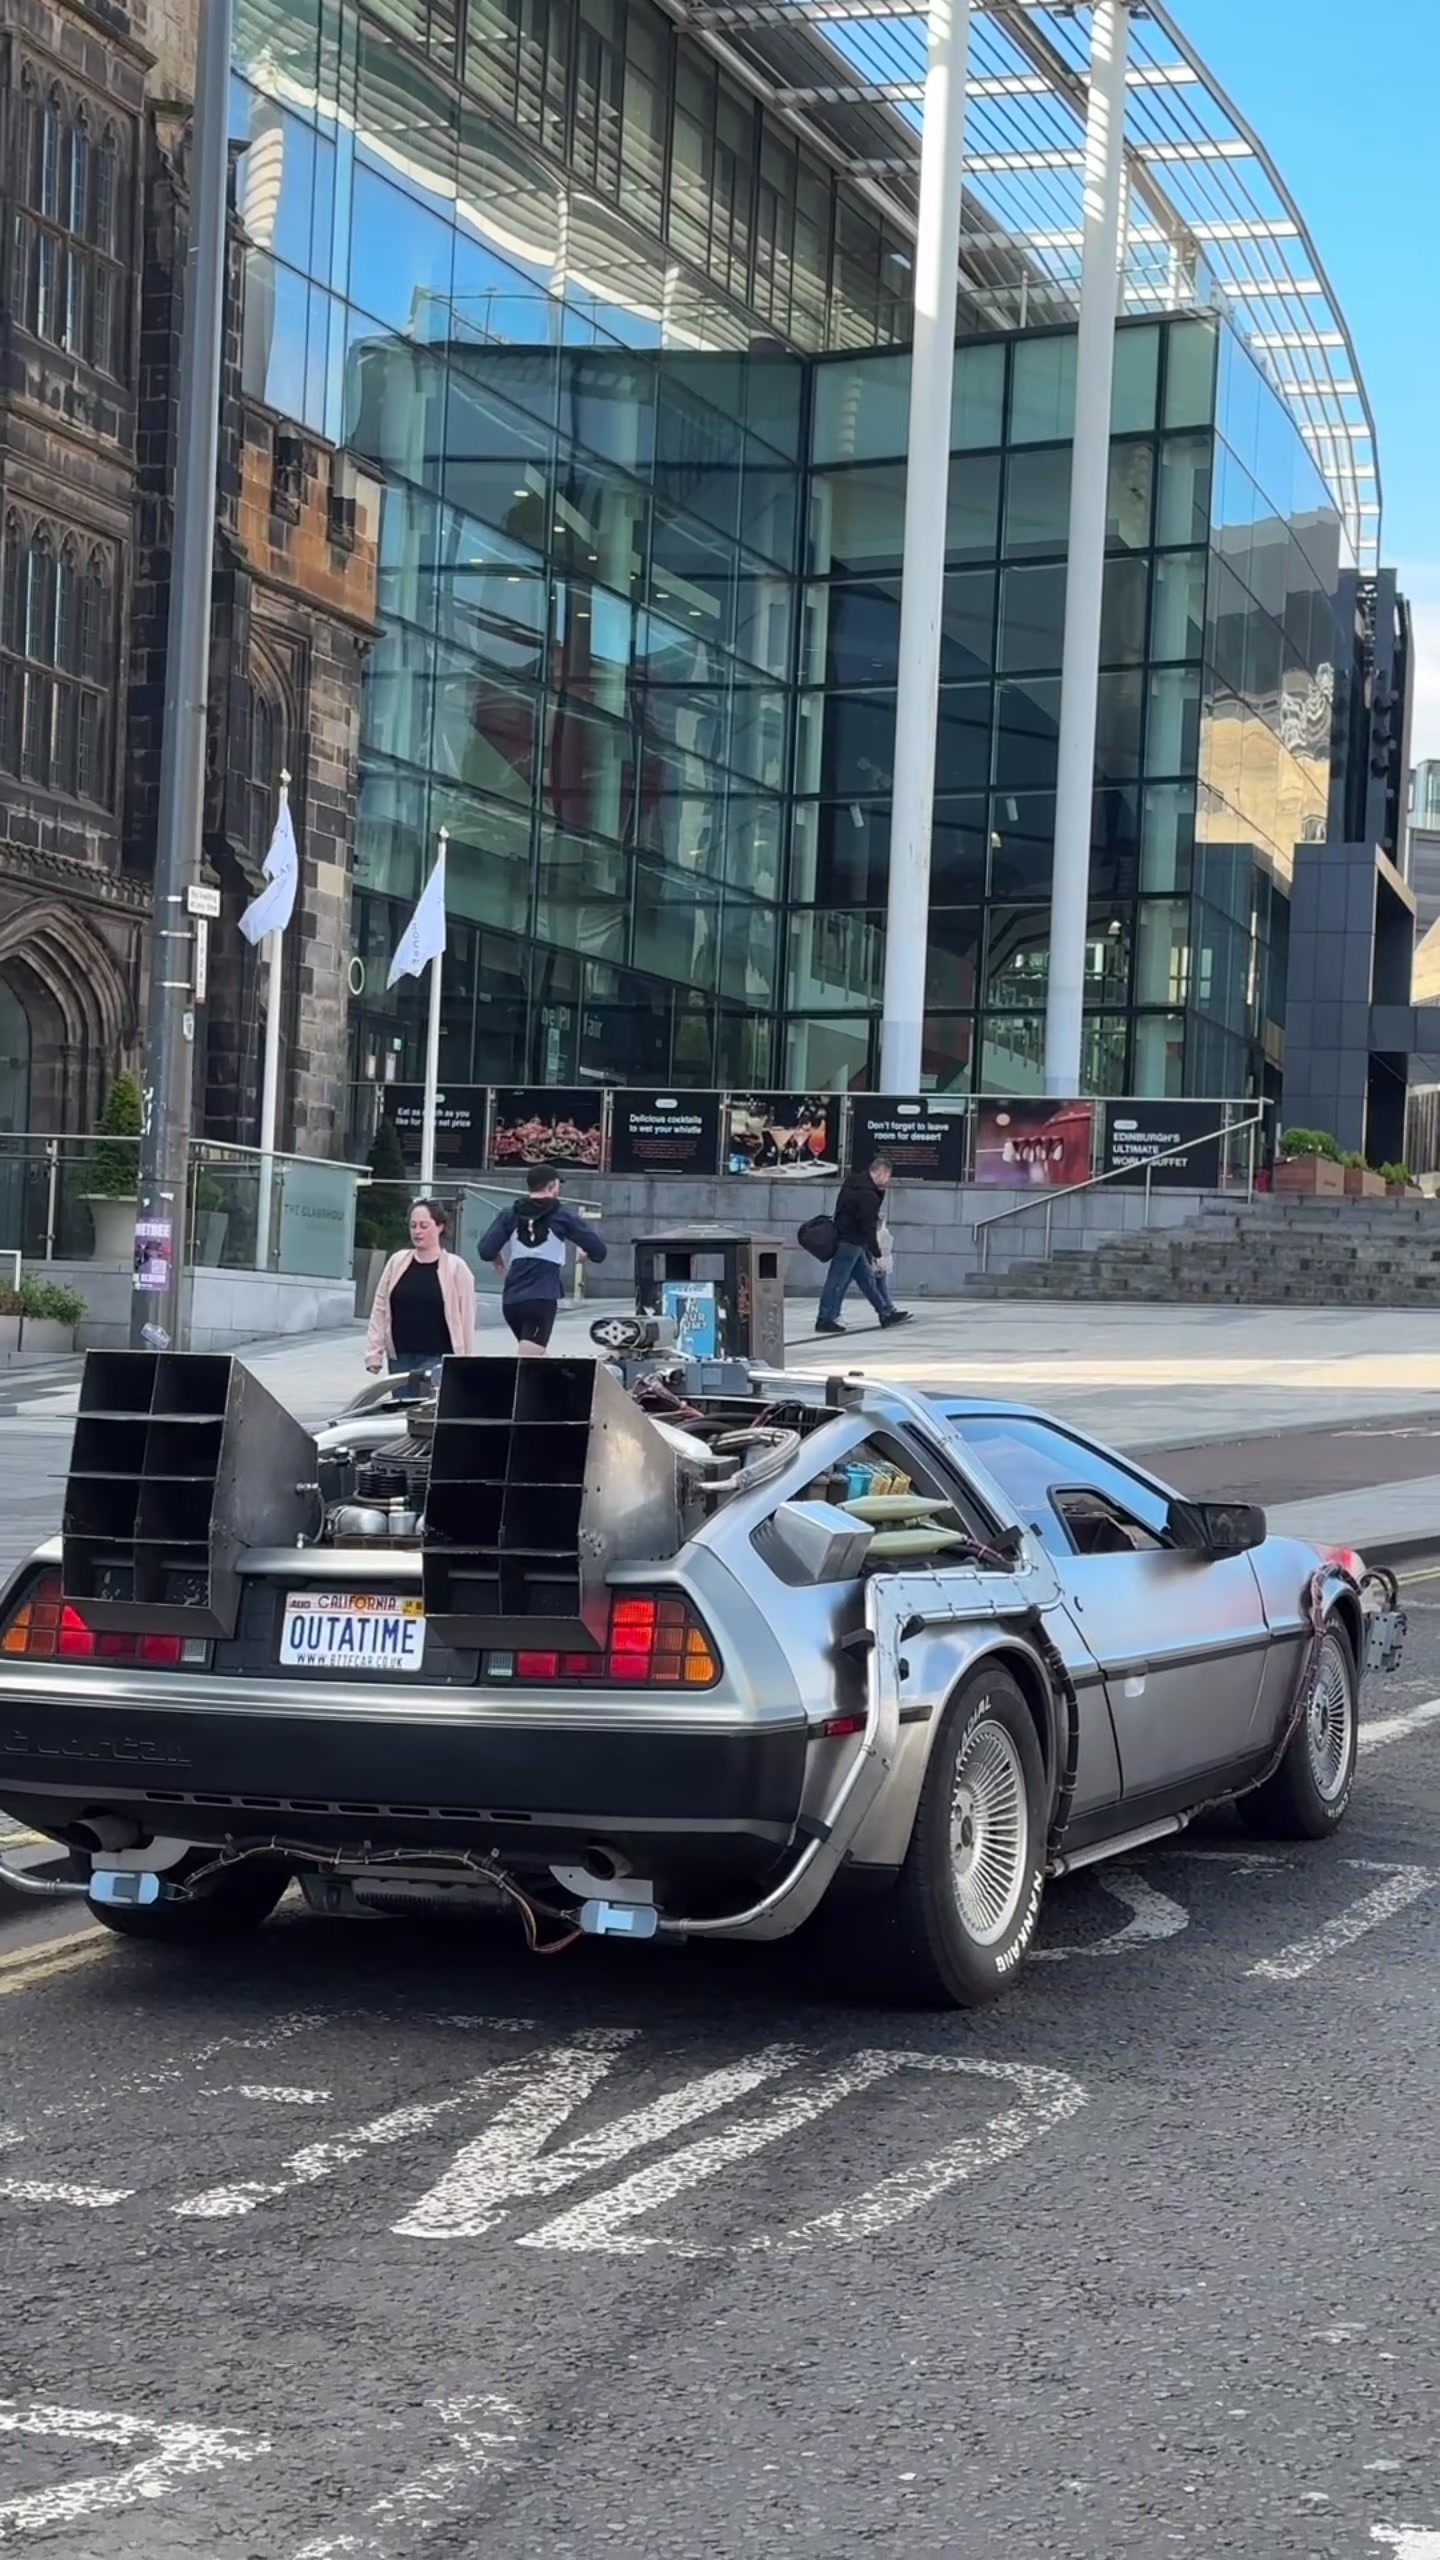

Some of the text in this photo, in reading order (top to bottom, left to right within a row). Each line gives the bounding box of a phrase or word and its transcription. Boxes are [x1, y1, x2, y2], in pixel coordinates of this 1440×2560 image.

[397, 1107, 411, 1116] Eat
[455, 1110, 470, 1119] you
[629, 1113, 703, 1124] Delicious cocktails
[395, 1117, 409, 1125] like
[410, 1117, 422, 1125] for
[451, 1119, 471, 1129] price
[867, 1120, 950, 1132] Don't forget to leave
[629, 1124, 637, 1132] to
[654, 1126, 673, 1135] your
[674, 1125, 702, 1134] whistle
[874, 1131, 942, 1141] room for dessert
[1113, 1132, 1181, 1143] EDINBURGH'S
[1112, 1144, 1160, 1154] ULTIMATE
[318, 1595, 397, 1611] CALIFORNIA
[290, 1615, 417, 1654] OUTATIME
[995, 1869, 1043, 1973] NANKANG
